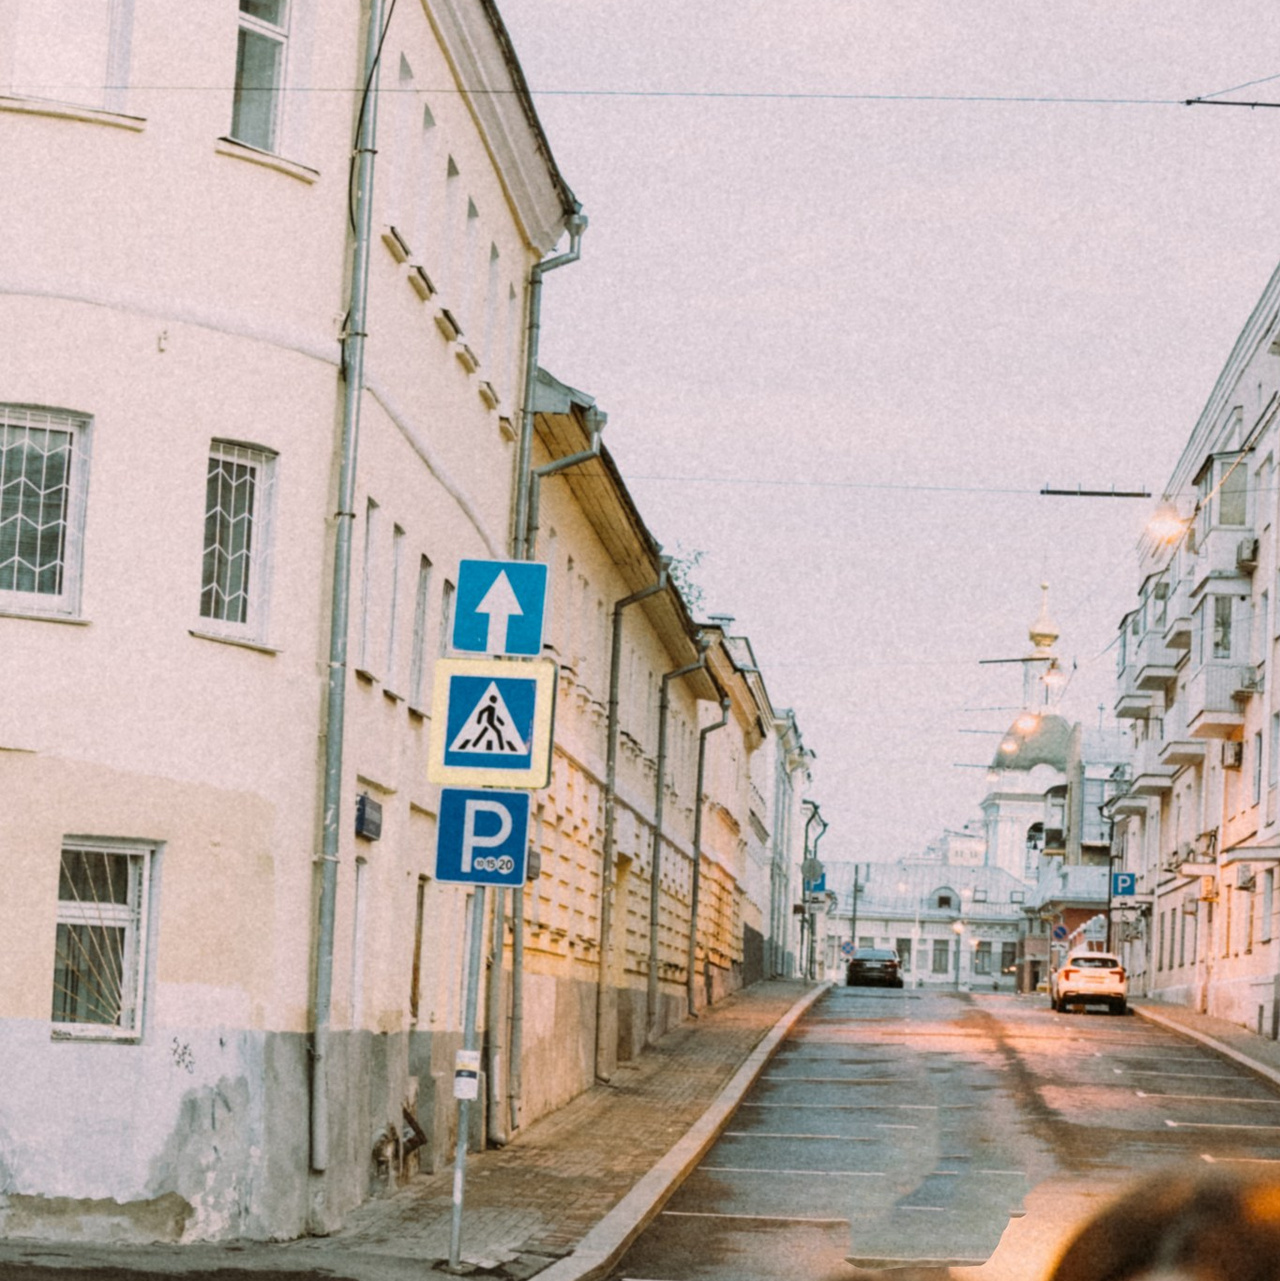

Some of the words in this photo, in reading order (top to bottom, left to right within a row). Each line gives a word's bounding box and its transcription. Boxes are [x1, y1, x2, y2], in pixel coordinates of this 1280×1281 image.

[461, 799, 513, 873] P
[487, 860, 496, 869] 15
[499, 859, 513, 870] 20
[1118, 875, 1131, 893] P
